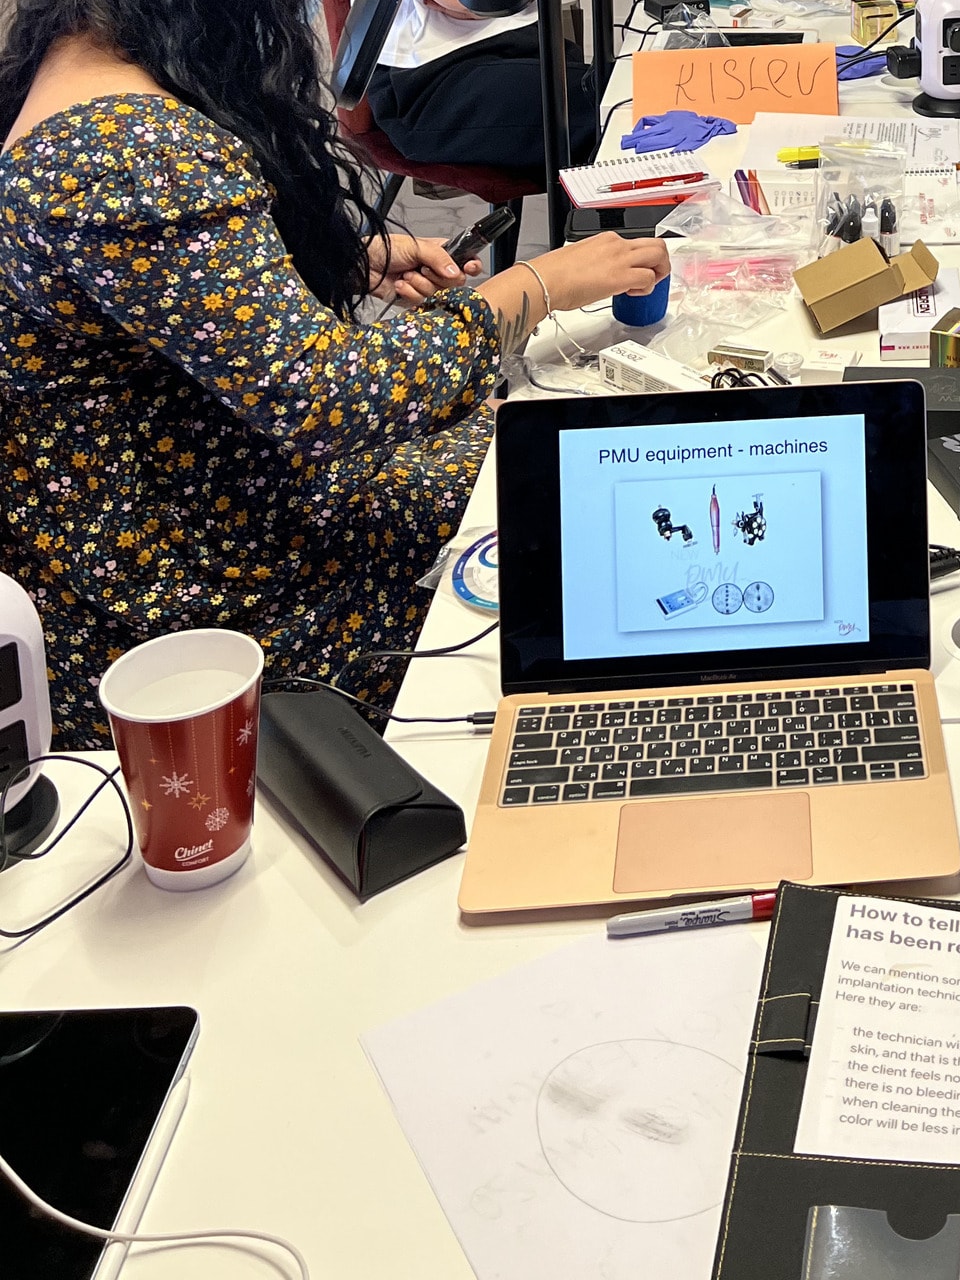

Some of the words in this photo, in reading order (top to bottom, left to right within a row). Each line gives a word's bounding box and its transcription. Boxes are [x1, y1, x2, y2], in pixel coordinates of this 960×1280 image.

[599, 447, 639, 464] PMU
[645, 443, 733, 464] equipment
[749, 438, 827, 456] machines
[175, 839, 213, 860] Chinet
[850, 904, 897, 922] How
[903, 912, 923, 926] to
[929, 917, 959, 932] tell
[847, 925, 883, 941] has
[890, 930, 941, 951] been
[841, 960, 860, 971] We
[864, 965, 886, 975] can
[889, 969, 939, 982] mention
[838, 975, 914, 995] implantation
[836, 991, 865, 1004] Here
[869, 996, 895, 1010] they
[899, 1002, 921, 1012] are:
[853, 1027, 873, 1038] the
[877, 1031, 942, 1047] technician
[850, 1044, 878, 1058] skin,
[882, 1050, 906, 1060] and
[910, 1052, 935, 1064] that
[939, 1055, 948, 1064] is
[848, 1060, 868, 1071] the
[872, 1065, 907, 1077] client
[911, 1068, 941, 1081] feels
[945, 1074, 960, 1083] no
[845, 1077, 878, 1091] there
[882, 1082, 892, 1092] is
[896, 1086, 912, 1095] no
[842, 1096, 878, 1109] when
[882, 1101, 937, 1117] cleaning
[839, 1114, 873, 1126] color
[876, 1118, 898, 1129] will
[901, 1120, 918, 1131] be
[922, 1122, 948, 1134] less
